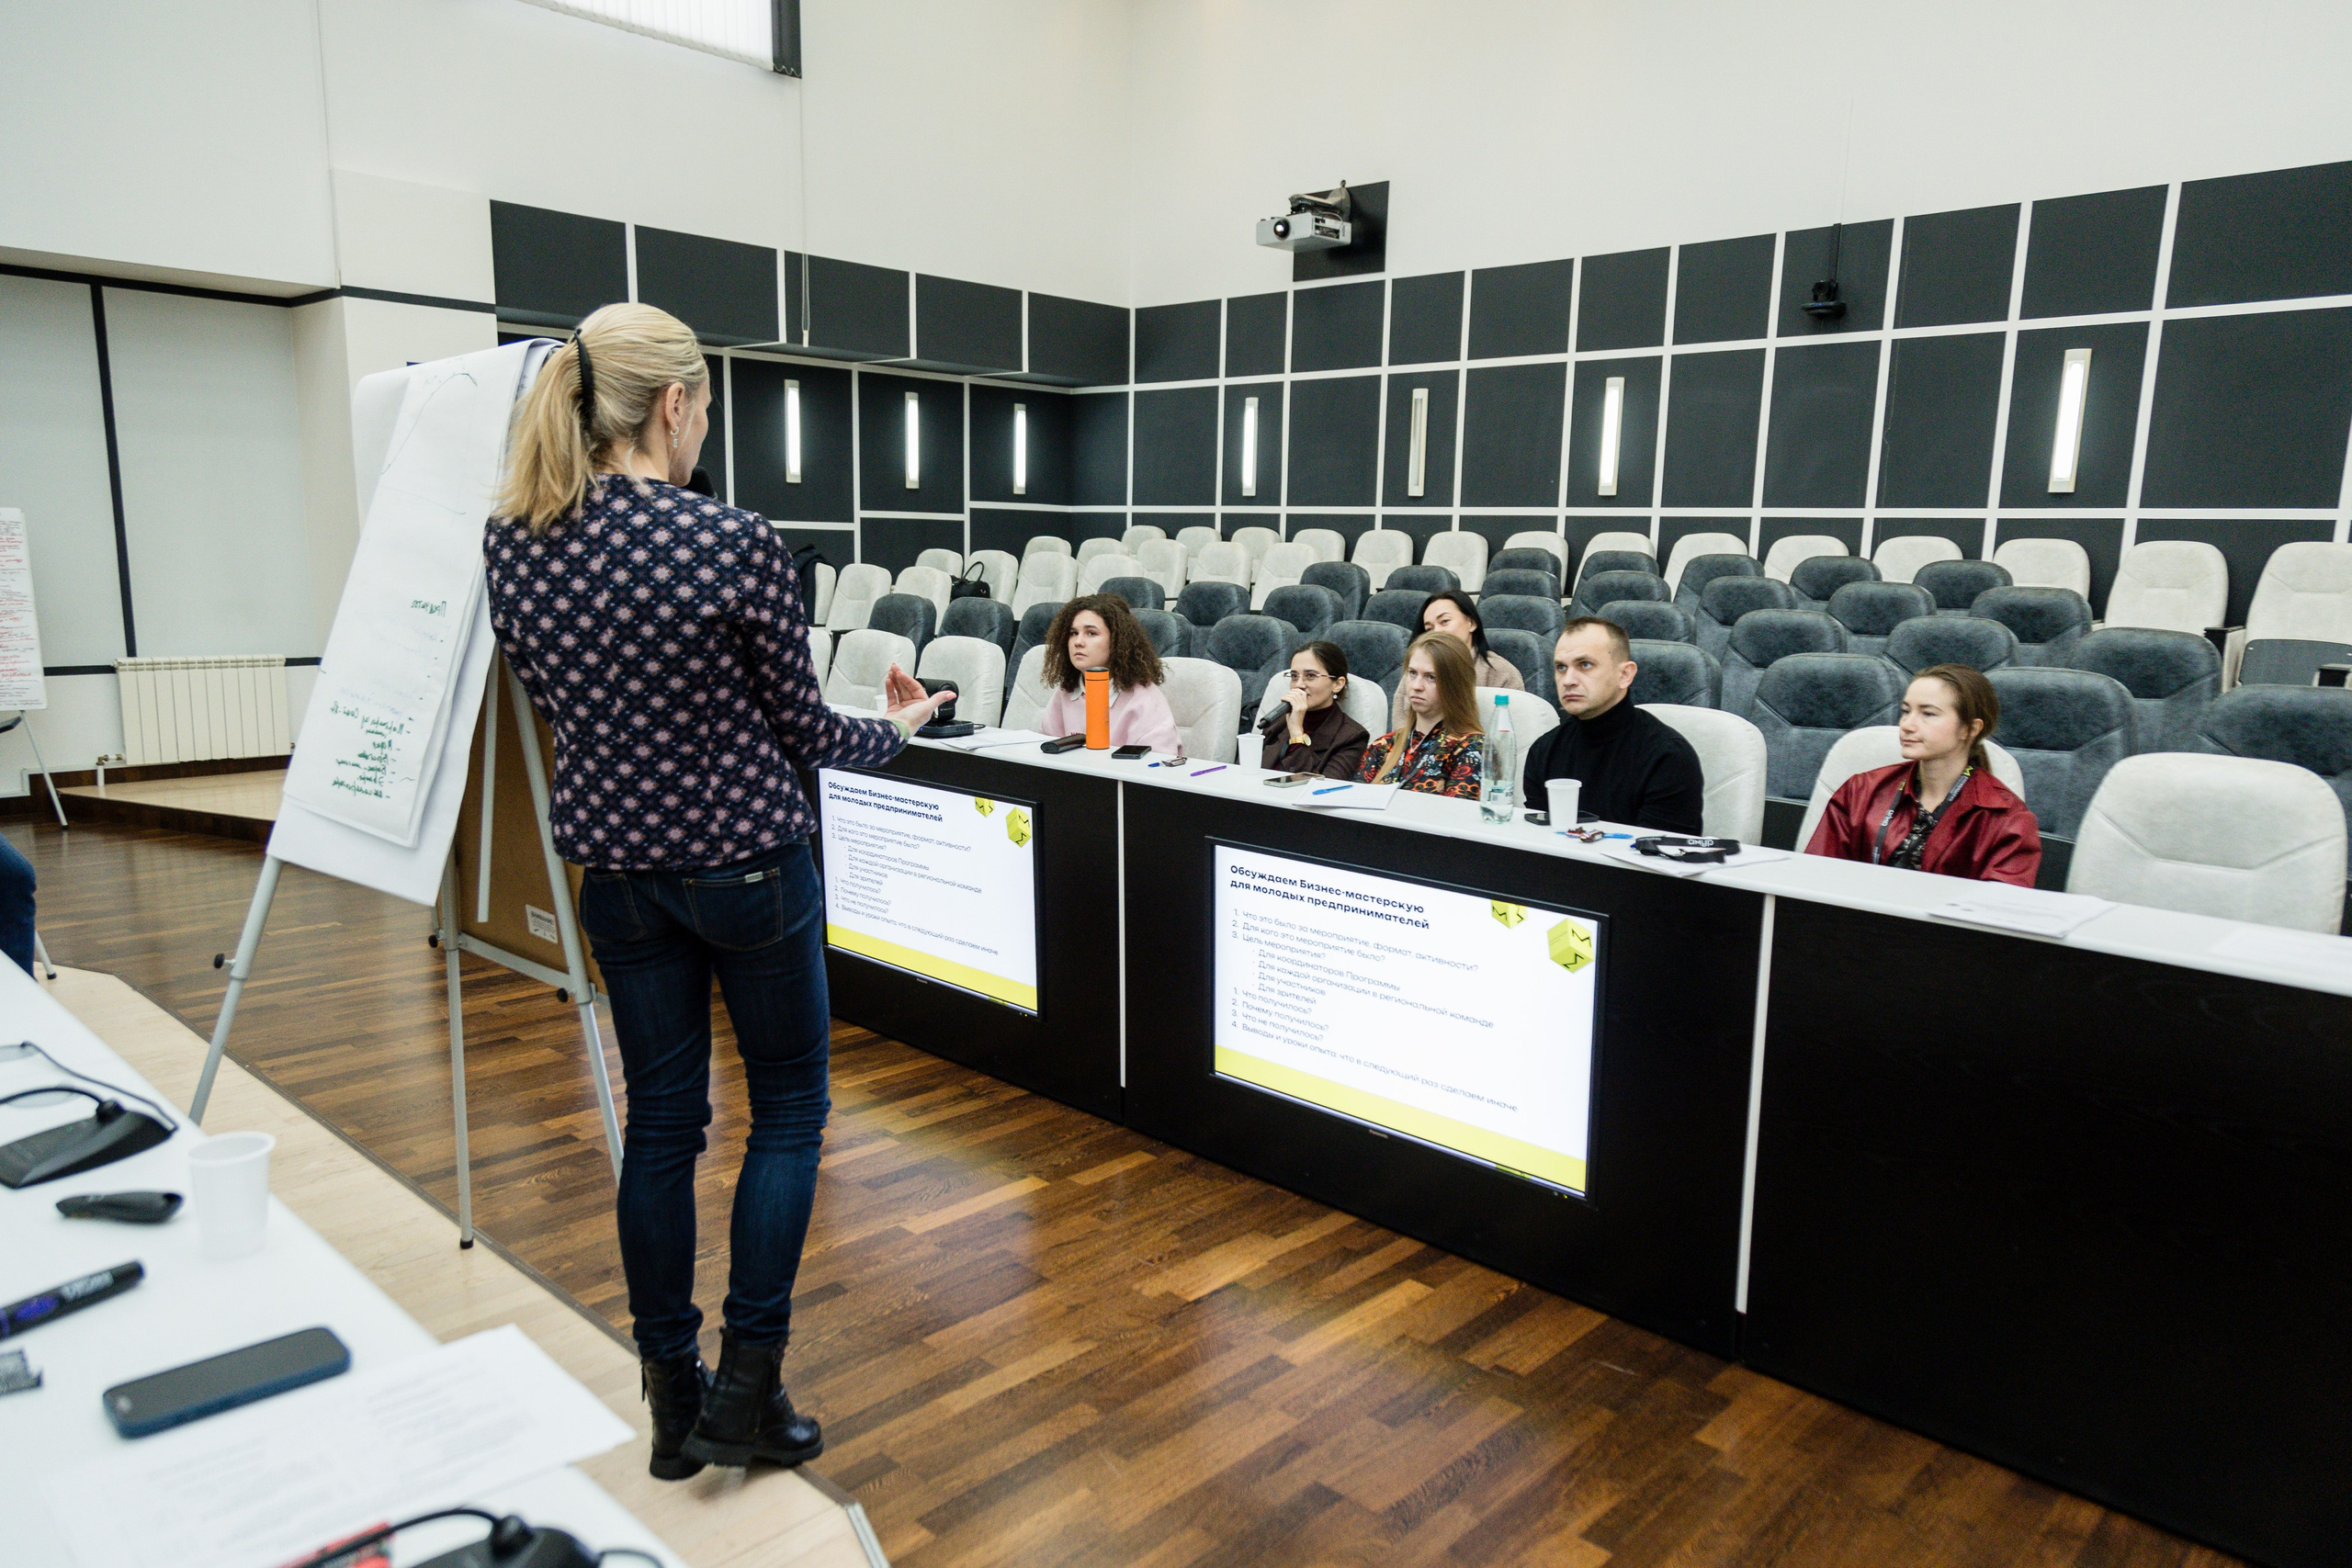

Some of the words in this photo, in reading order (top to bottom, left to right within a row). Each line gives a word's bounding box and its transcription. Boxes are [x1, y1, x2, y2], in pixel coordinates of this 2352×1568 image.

[828, 781, 868, 795] Обсуждаем
[867, 789, 940, 811] Бизнес-мастерскую
[828, 793, 842, 801] для
[842, 795, 873, 807] молодых
[873, 802, 944, 822] предпринимателей
[1229, 864, 1297, 887] Обсуждаем
[1299, 878, 1425, 914] Бизнес-мастерскую
[1229, 879, 1251, 890] для
[1252, 885, 1306, 903] молодых
[1306, 896, 1430, 930] предпринимателей
[1242, 910, 1258, 921] Что
[1259, 915, 1273, 925] это
[1273, 918, 1297, 931] было
[1297, 924, 1308, 933] за
[1415, 952, 1479, 972] активности?
[1242, 921, 1260, 932] Для
[1260, 928, 1280, 938] кого
[1280, 931, 1295, 942] это
[1295, 936, 1355, 956] мероприятие
[1356, 949, 1385, 963] было?
[1242, 933, 1263, 945] Цель
[1264, 940, 1327, 959] мероприятия?
[1258, 948, 1276, 959] Для
[1276, 954, 1345, 977] координаторов
[1346, 970, 1401, 992] Программы
[1258, 971, 1275, 982] Для
[1276, 977, 1327, 997] участников
[1241, 989, 1258, 1000] Что
[1258, 995, 1313, 1015] получилось?
[1258, 982, 1275, 994] Для
[1276, 988, 1317, 1005] зрителей
[1258, 960, 1276, 971] Для
[1276, 966, 1311, 980] каждой
[1311, 976, 1371, 996] организации
[1379, 993, 1448, 1016] региональной
[1449, 1011, 1495, 1029] команде
[1241, 1000, 1273, 1018] Почему
[1273, 1010, 1329, 1032] получилось?
[1241, 1011, 1258, 1023] Что
[1258, 1018, 1268, 1026] не
[1269, 1021, 1324, 1042] получилось?
[1241, 1022, 1274, 1039] Выводы
[1282, 1036, 1308, 1049] уроки
[1339, 1054, 1355, 1064] что
[1363, 1060, 1419, 1082] следующий
[1420, 1077, 1439, 1089] раз
[1440, 1084, 1485, 1102] сделаем
[1487, 1098, 1519, 1112] иначе
